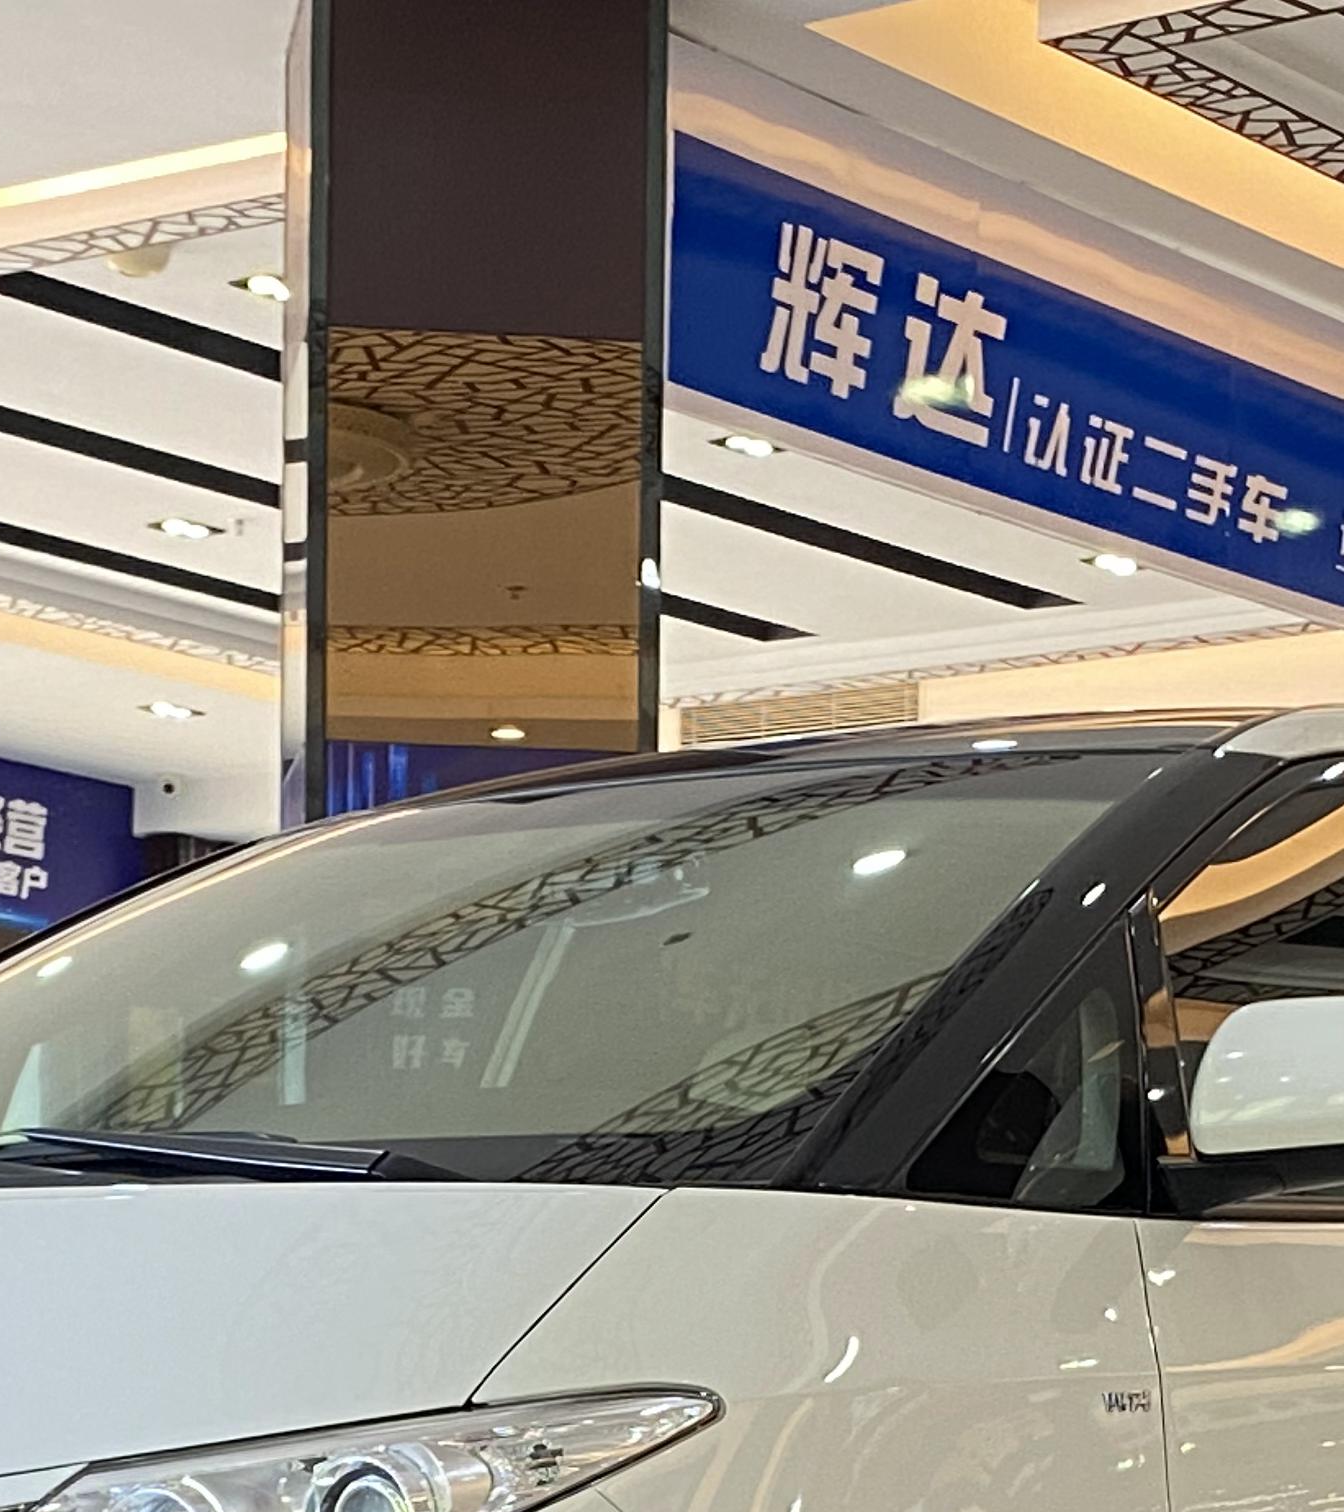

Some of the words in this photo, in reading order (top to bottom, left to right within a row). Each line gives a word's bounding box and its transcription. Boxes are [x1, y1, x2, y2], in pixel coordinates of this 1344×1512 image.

[760, 221, 1007, 448] 辉达
[1023, 393, 1288, 543] 认证二手车
